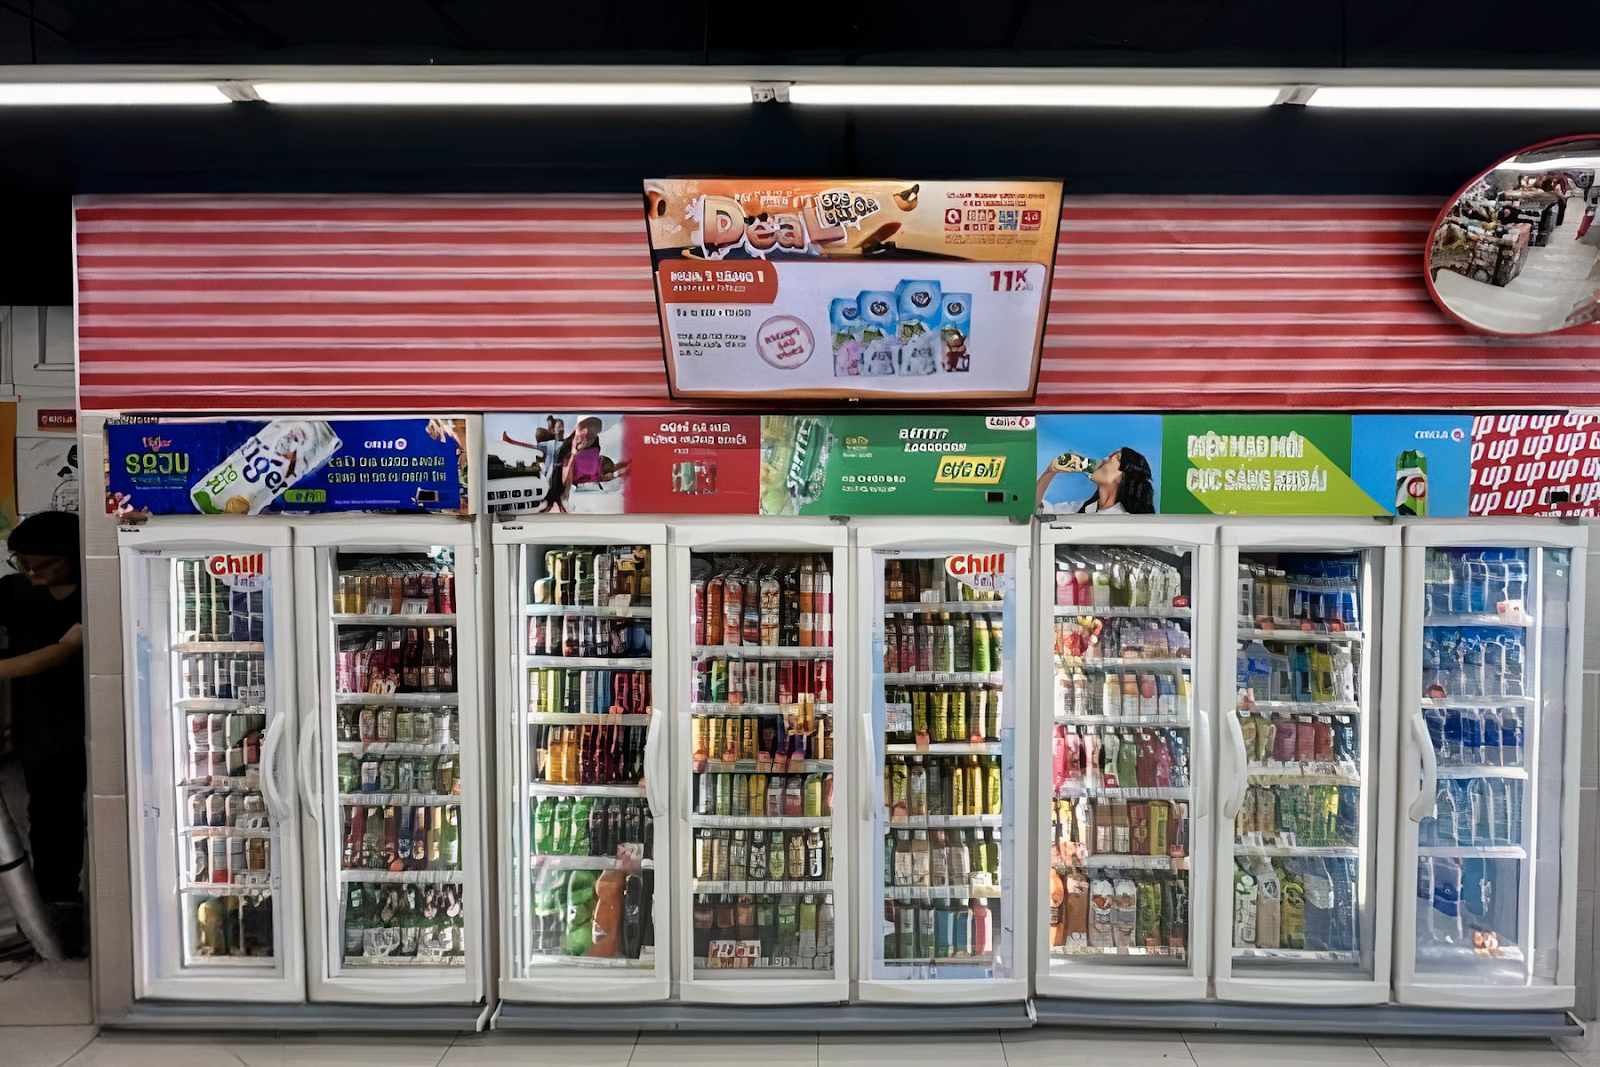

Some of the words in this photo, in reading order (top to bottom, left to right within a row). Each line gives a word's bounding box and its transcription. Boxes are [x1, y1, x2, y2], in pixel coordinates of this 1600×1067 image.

[1487, 438, 1519, 464] up
[1522, 434, 1554, 460] up
[1555, 432, 1587, 457] up
[1479, 465, 1512, 491] up
[1514, 461, 1546, 487] up
[1547, 458, 1579, 483] up
[1469, 491, 1502, 516] up
[1504, 488, 1536, 513] up
[210, 553, 264, 575] Chill
[950, 553, 1005, 575] Chill
